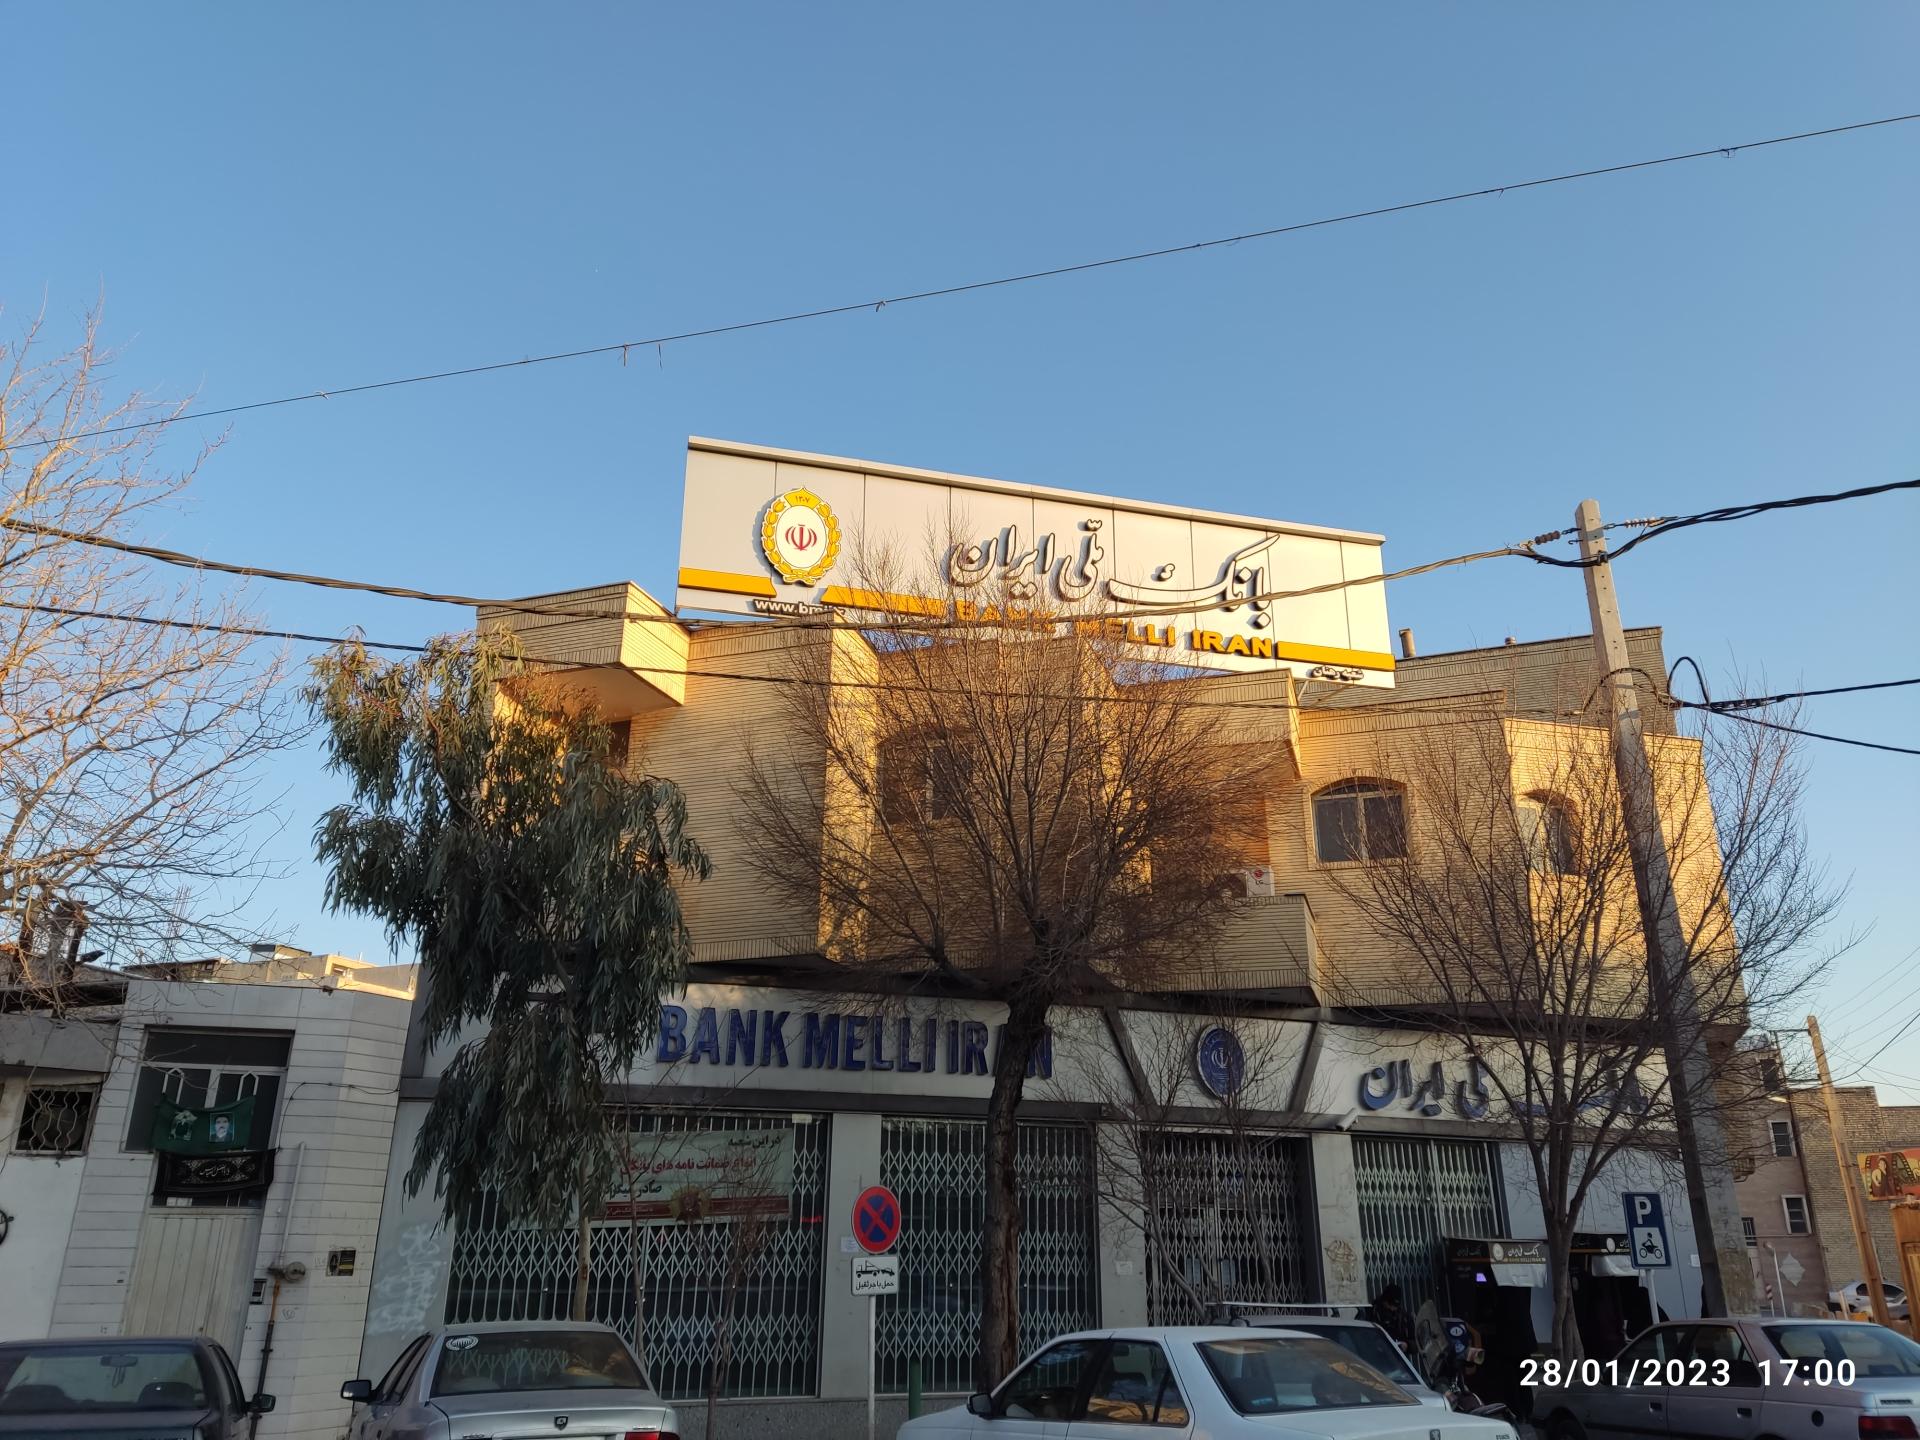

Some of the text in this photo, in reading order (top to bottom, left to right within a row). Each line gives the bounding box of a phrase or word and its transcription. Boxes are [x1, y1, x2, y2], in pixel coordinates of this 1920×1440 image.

[947, 523, 1056, 600] ایران
[1107, 533, 1280, 629] بانک
[1191, 629, 1273, 658] IRAN
[656, 1004, 1053, 1079] BANK MELLI IRN
[1361, 1058, 1446, 1117] ایران
[728, 1134, 782, 1149] در این شعبه
[652, 1158, 674, 1174] های
[675, 1157, 695, 1170] نامه
[1634, 1196, 1652, 1225] P
[856, 1280, 877, 1291] جرثقیل
[881, 1280, 895, 1290] حمل
